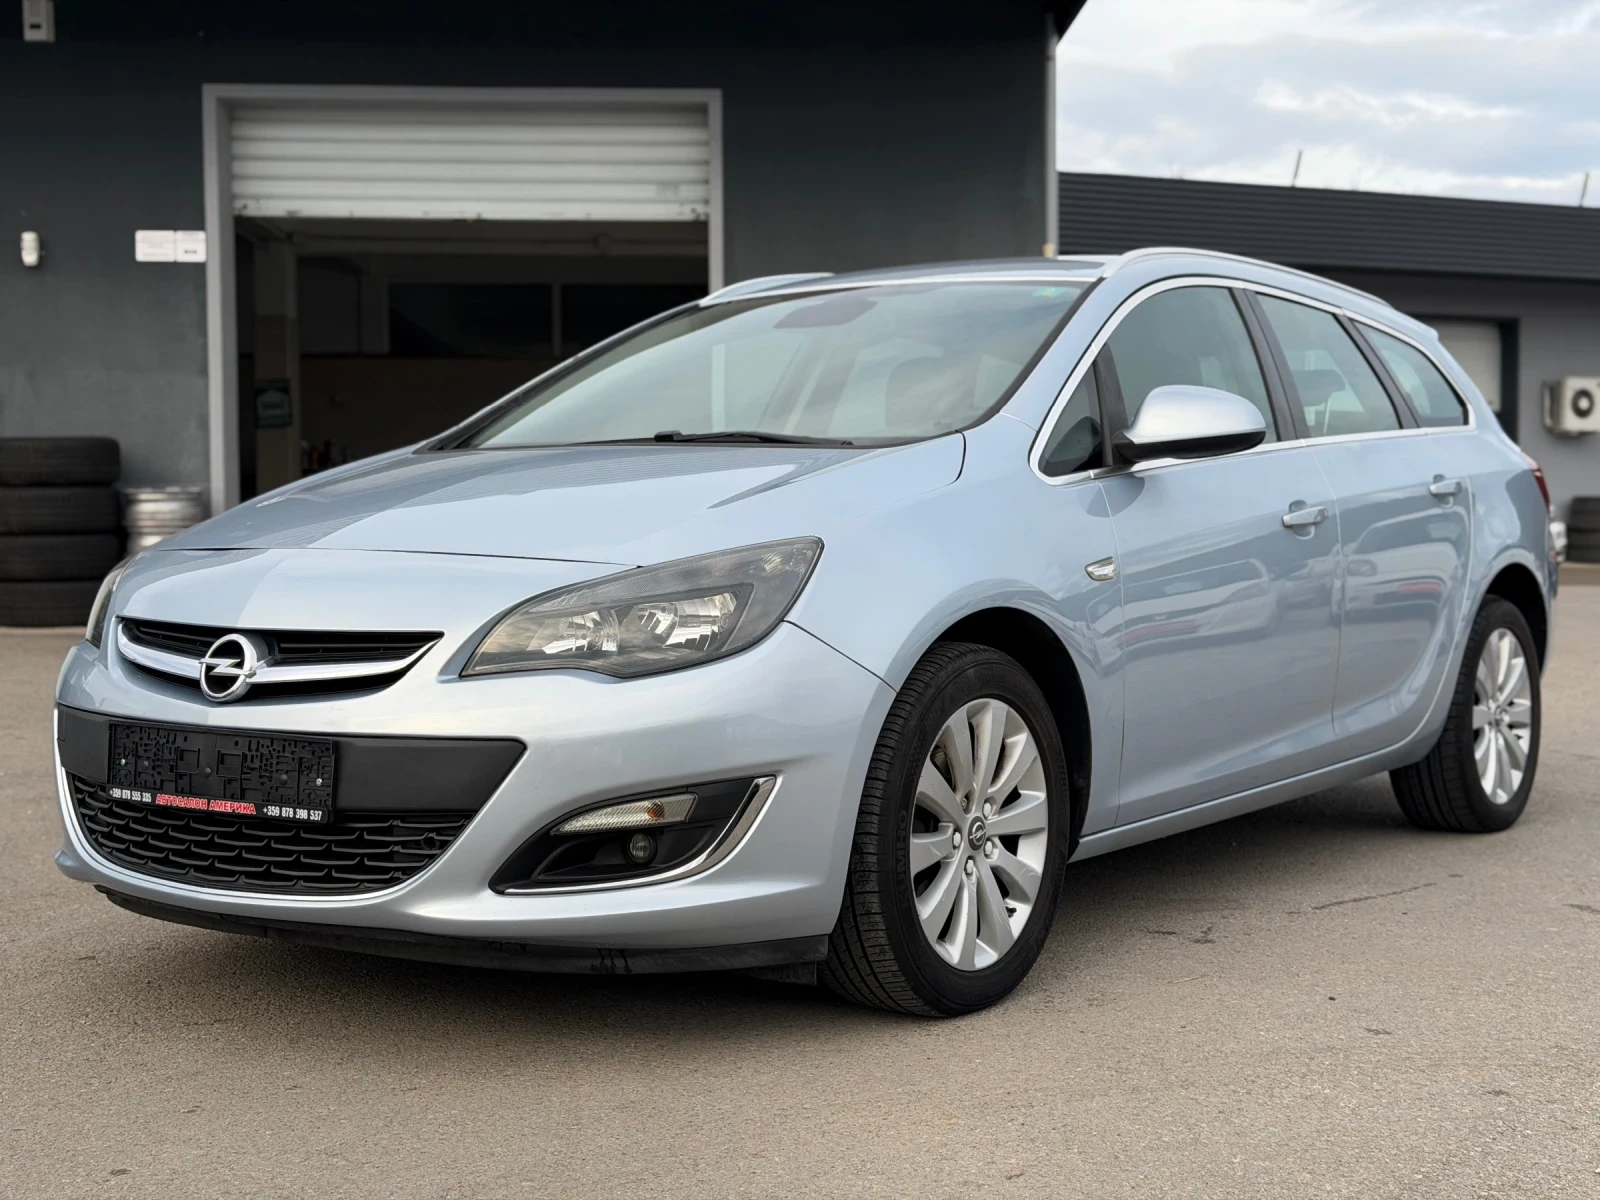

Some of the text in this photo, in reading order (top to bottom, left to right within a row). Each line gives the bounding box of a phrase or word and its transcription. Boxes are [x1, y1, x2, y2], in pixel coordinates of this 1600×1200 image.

[110, 788, 121, 798] +359
[132, 791, 141, 801] 555
[142, 792, 152, 803] 335
[156, 793, 208, 810] АВТОСАЛОН
[209, 800, 256, 814] АМЕРИКА
[262, 805, 280, 817] +359
[281, 807, 294, 818] 878
[295, 808, 308, 820] 398
[309, 810, 322, 821] 537
[896, 809, 908, 907] KUMHO
